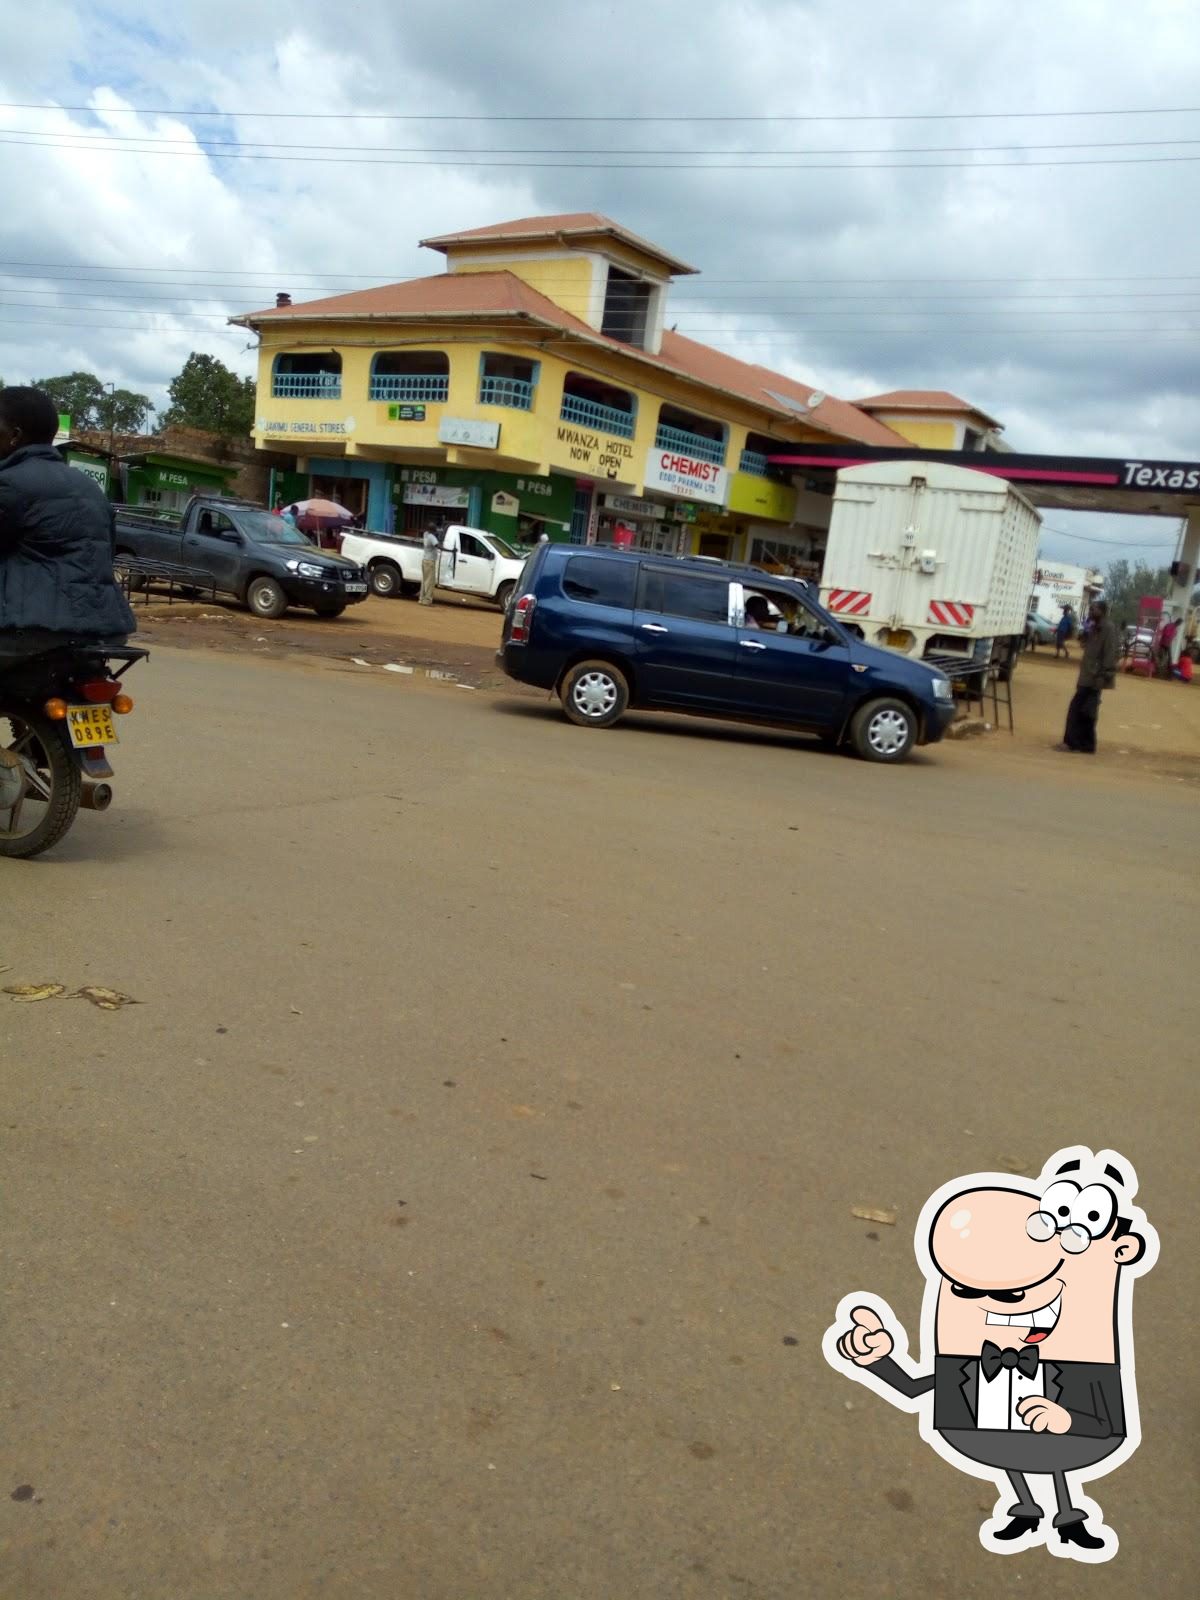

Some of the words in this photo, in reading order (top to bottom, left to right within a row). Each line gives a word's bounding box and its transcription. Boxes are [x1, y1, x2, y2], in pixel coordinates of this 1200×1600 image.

[290, 423, 317, 433] GENERAL
[557, 427, 599, 450] MWANZA
[606, 440, 633, 458] HOTEL
[570, 447, 591, 462] NOW
[600, 454, 622, 468] OPEN
[660, 453, 720, 482] CHEMIST
[168, 473, 188, 485] PESA
[412, 470, 437, 484] PESA
[527, 481, 552, 496] PESA
[75, 725, 113, 742] 089E
